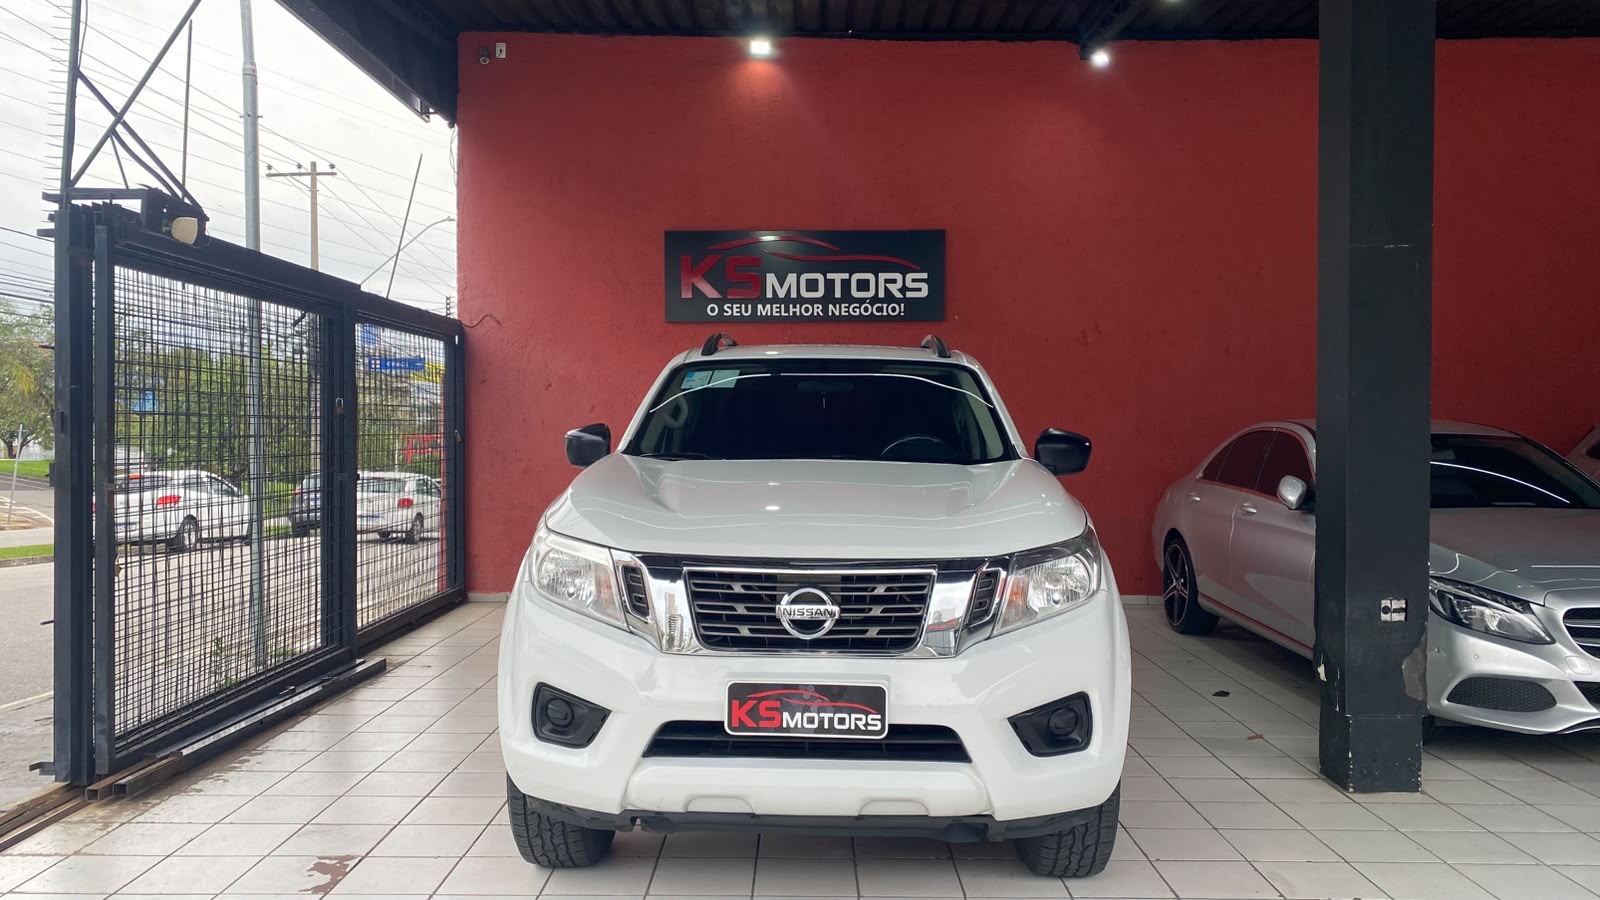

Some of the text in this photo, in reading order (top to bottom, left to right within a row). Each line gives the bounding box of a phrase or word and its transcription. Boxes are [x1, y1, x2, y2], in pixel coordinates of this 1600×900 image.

[680, 255, 928, 299] KS MOTORS
[706, 300, 905, 316] O SEU MELHOR NEGÓCIO!
[782, 607, 833, 617] NISSAN
[731, 700, 882, 731] KS MOTORS
